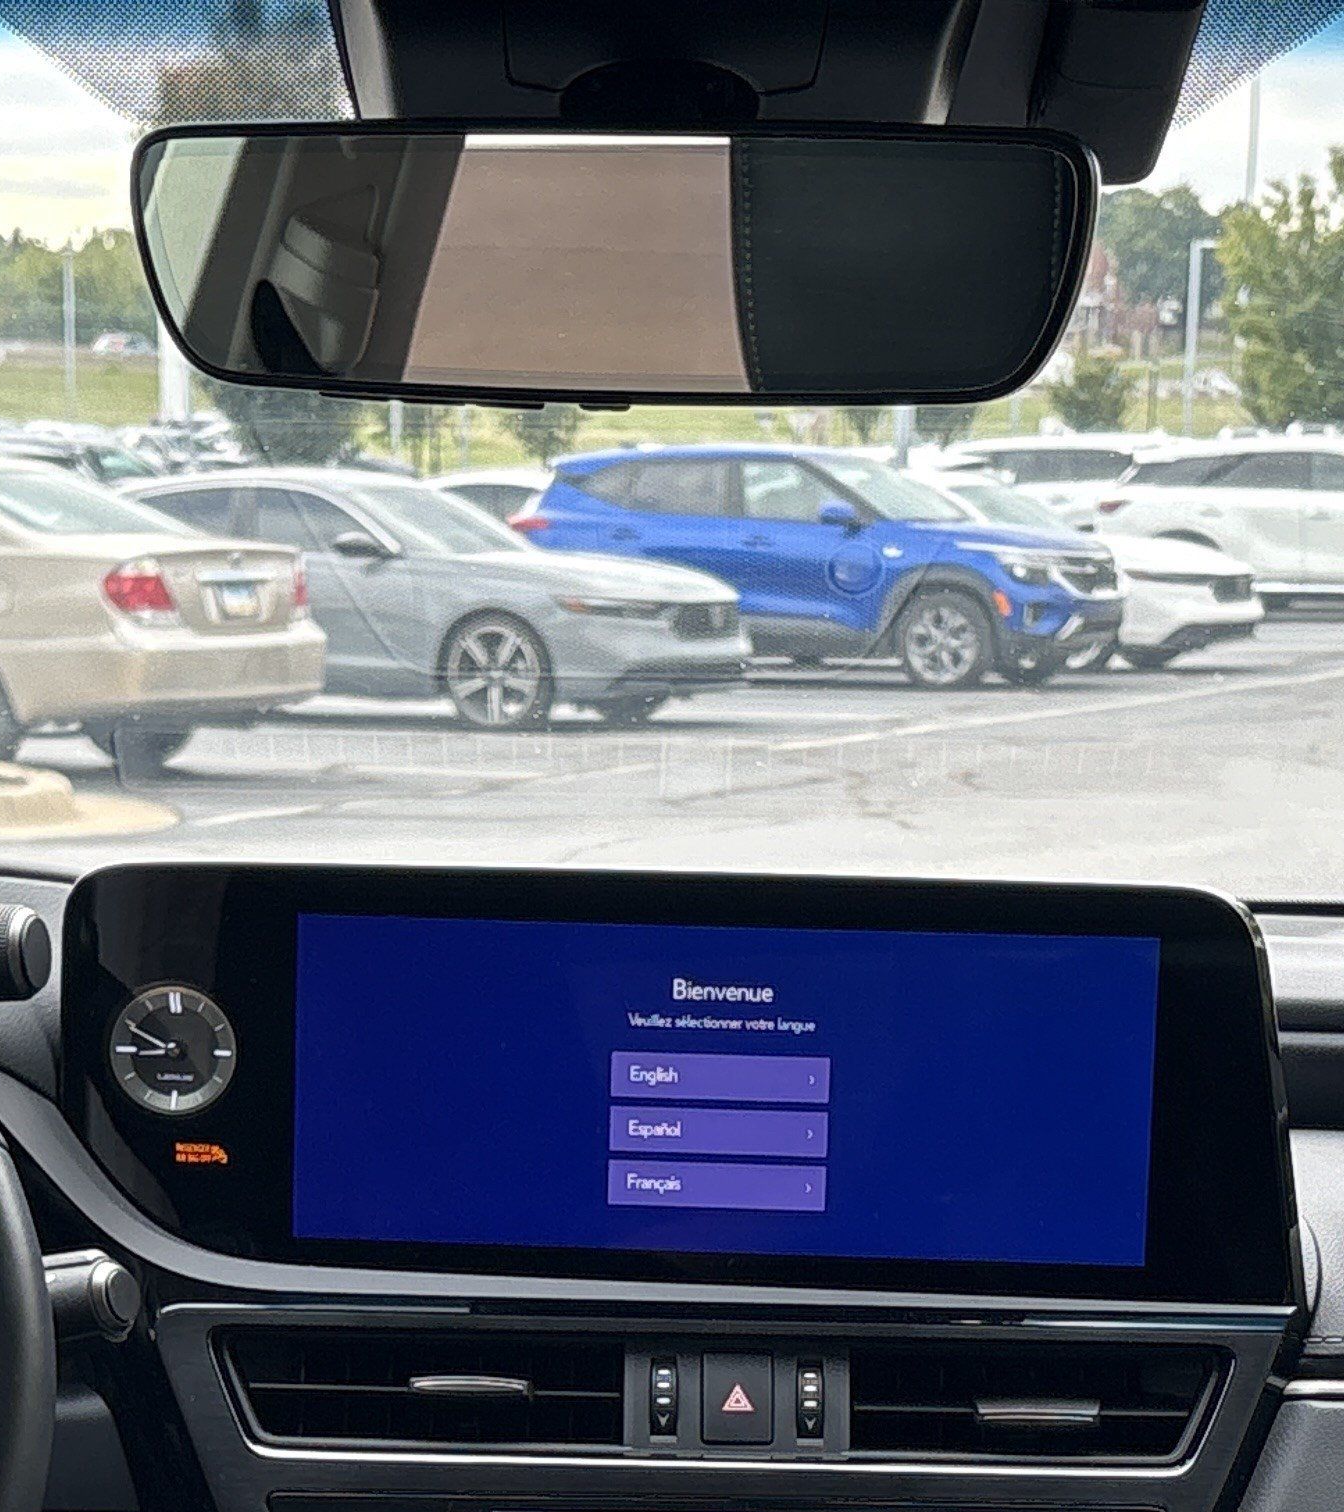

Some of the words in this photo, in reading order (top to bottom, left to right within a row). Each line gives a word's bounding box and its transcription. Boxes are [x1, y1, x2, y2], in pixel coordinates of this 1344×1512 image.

[673, 978, 774, 1003] Bienvenue
[627, 1012, 673, 1028] Veuillez
[745, 1018, 776, 1031] votre
[777, 1017, 817, 1034] langue
[629, 1064, 679, 1087] English
[628, 1119, 682, 1139] Español
[626, 1172, 682, 1195] Français
